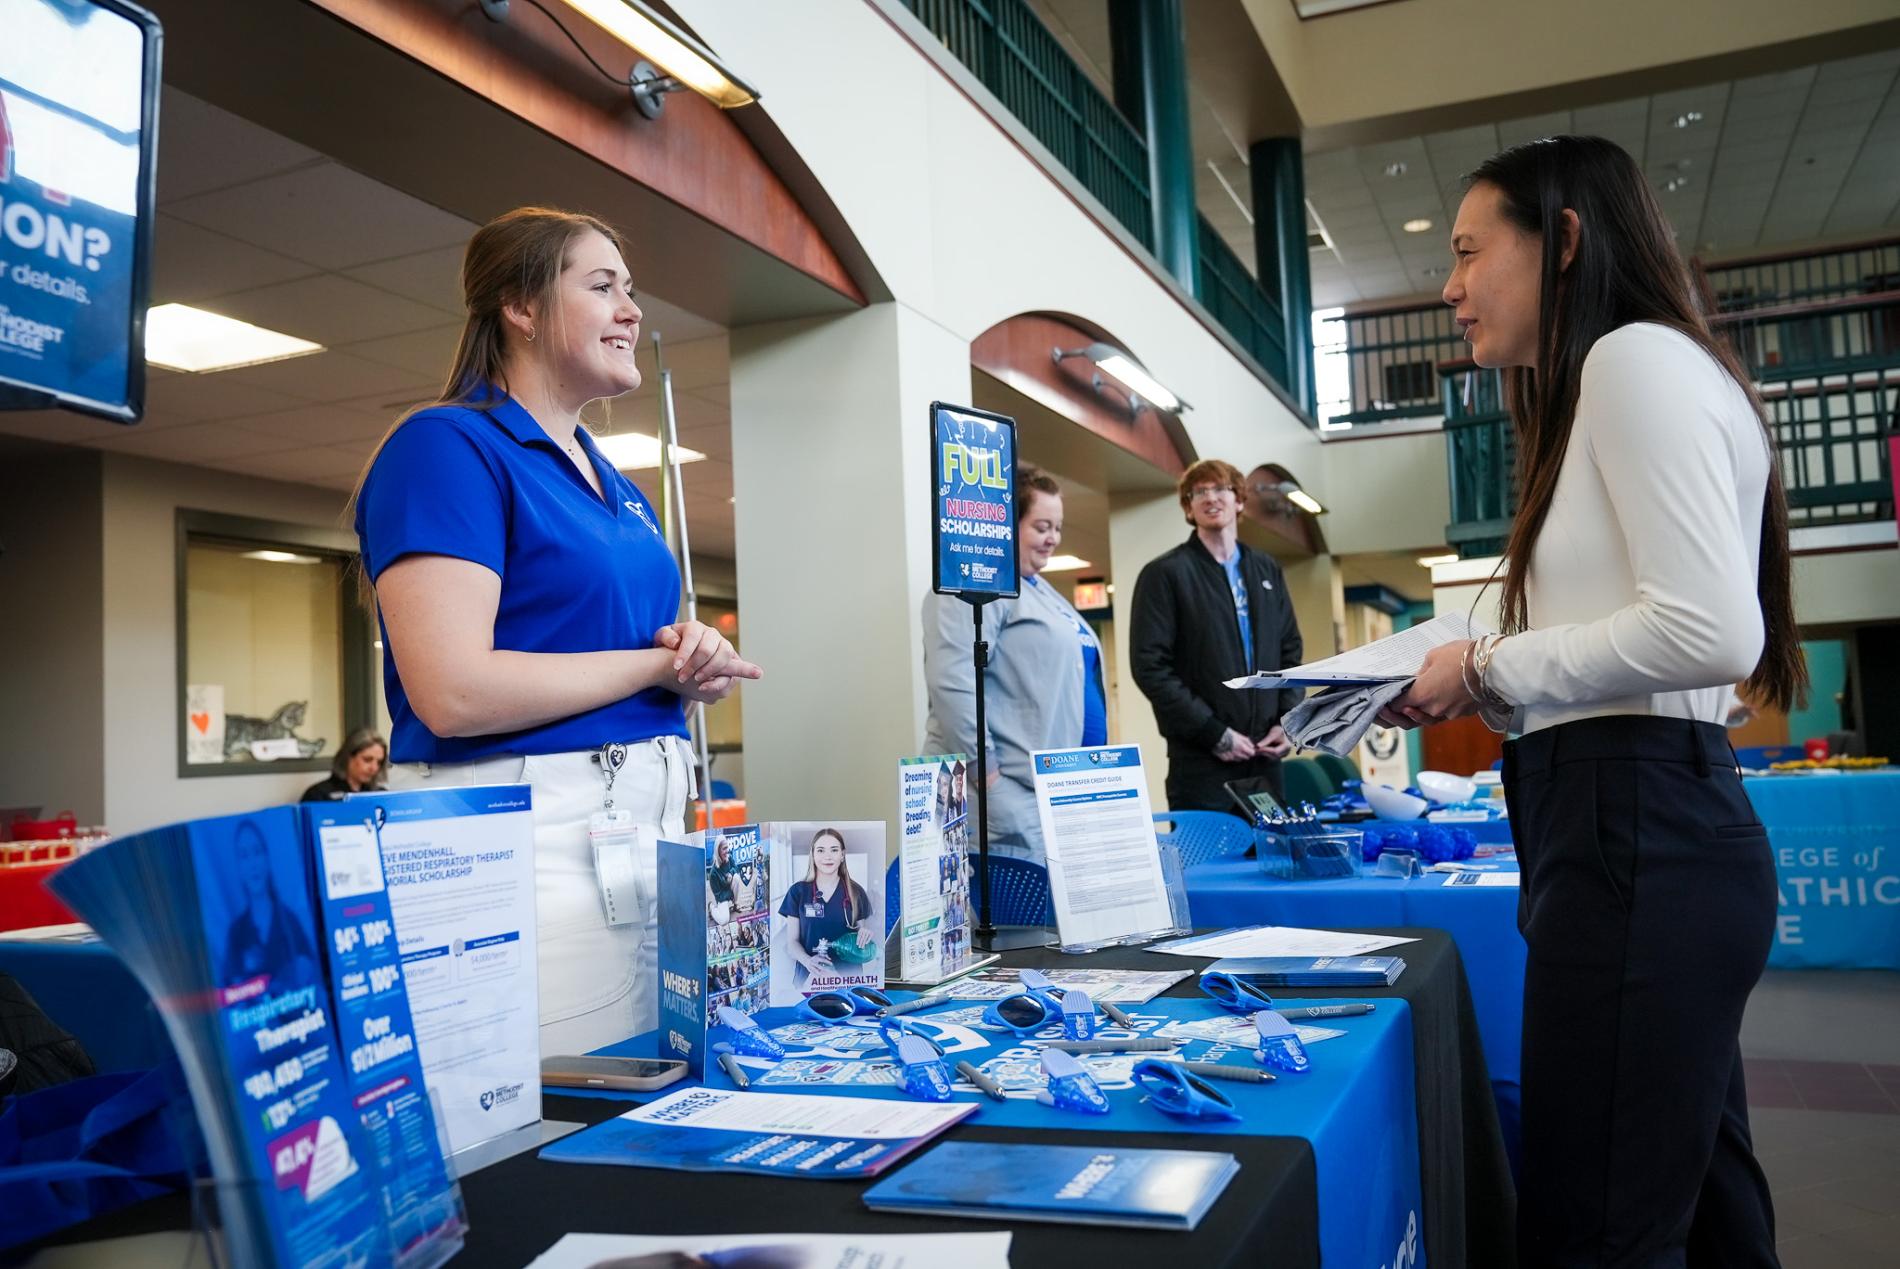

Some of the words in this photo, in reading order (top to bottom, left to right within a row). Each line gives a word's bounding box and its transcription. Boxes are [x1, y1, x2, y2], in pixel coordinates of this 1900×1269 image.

[0, 195, 111, 272] ON?
[11, 263, 91, 304] details.
[943, 442, 1008, 489] FULL
[946, 498, 1006, 521] NURSING
[940, 518, 1011, 541] SCHOLARSHIPS
[950, 542, 961, 552] Ask
[962, 545, 973, 554] me
[975, 544, 983, 554] for
[1051, 754, 1079, 764] DOANE
[905, 770, 932, 783] Dreaming
[1065, 778, 1090, 786] TRANSFER
[1090, 776, 1107, 784] CREDIT
[1107, 775, 1122, 783] GUIDE
[905, 785, 911, 796] of
[911, 783, 932, 796] nursing
[905, 796, 926, 808] school?
[906, 809, 931, 822] Dreading
[906, 823, 921, 835] debt?
[423, 855, 474, 870] RESPIRATORY
[476, 849, 514, 863] THERAPIST
[736, 844, 758, 862] LOVE
[1853, 846, 1885, 872] of
[420, 866, 472, 882] SCHOLARSHIP
[663, 969, 691, 998] WHERE
[811, 976, 841, 986] ALLIED
[843, 975, 878, 985] HEALTH
[663, 989, 699, 1024] MATTERS.
